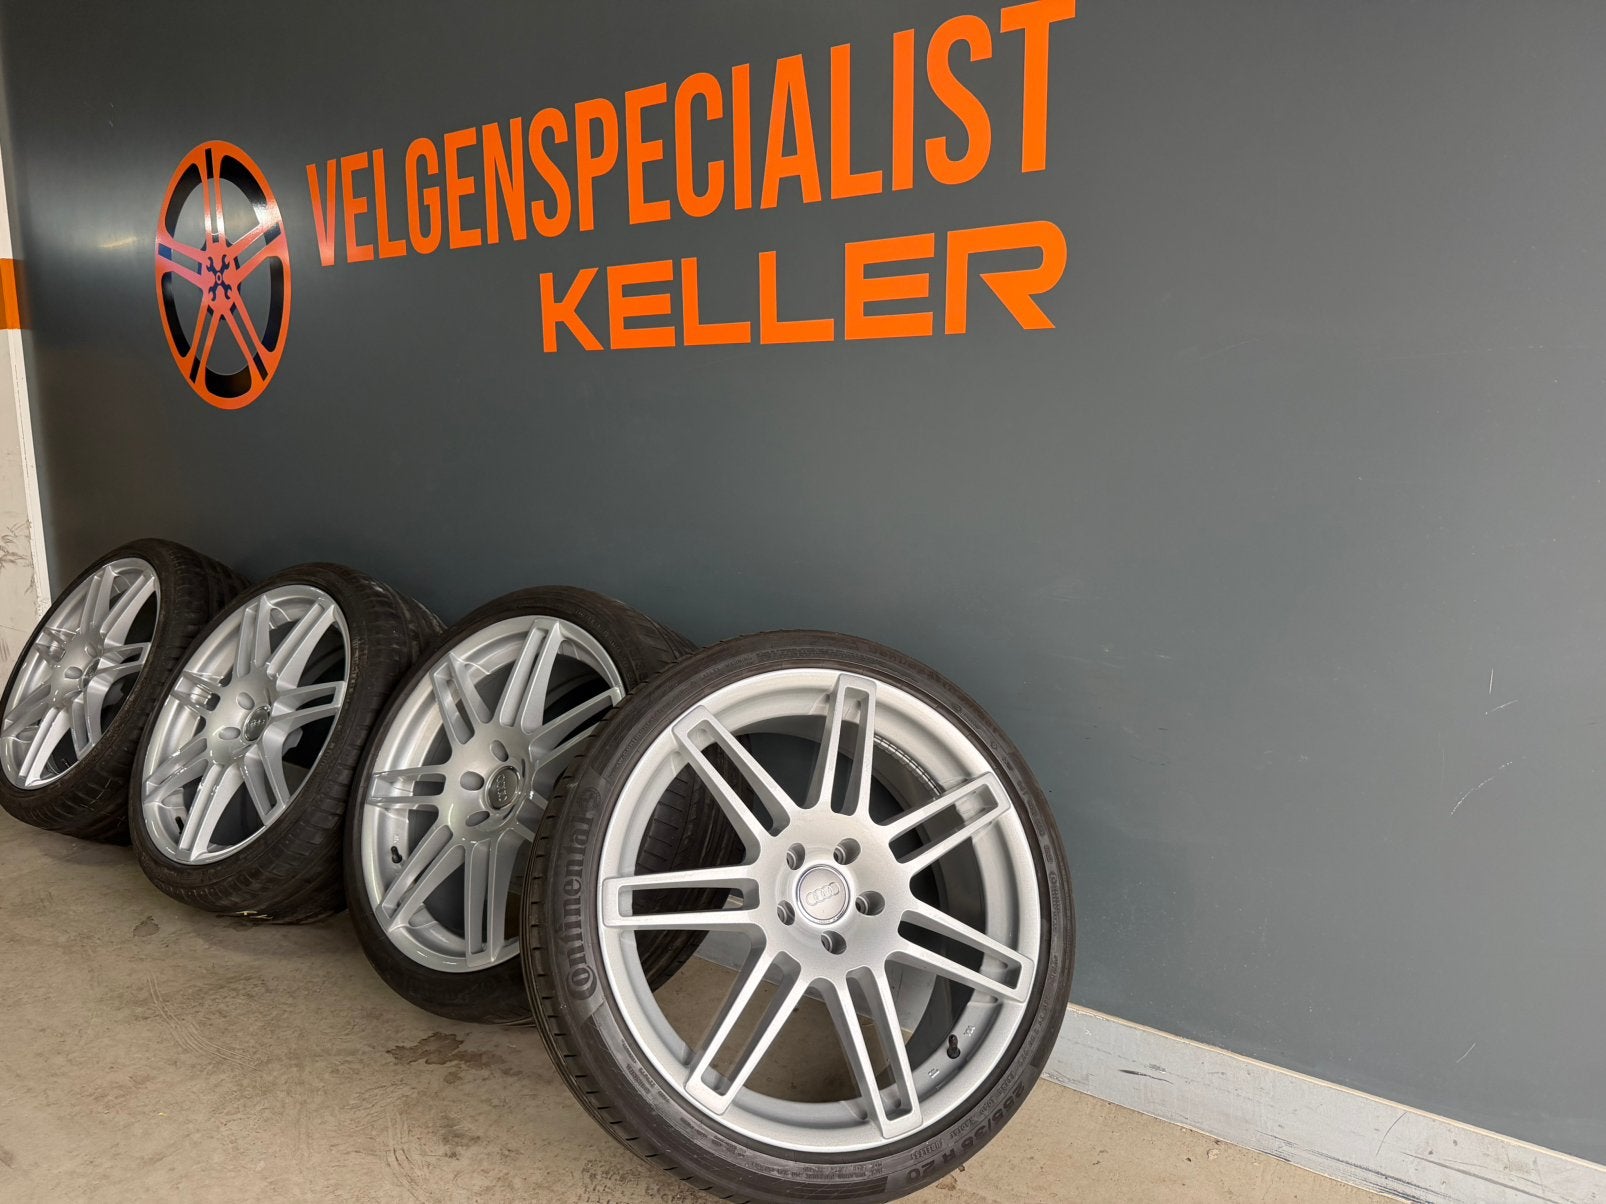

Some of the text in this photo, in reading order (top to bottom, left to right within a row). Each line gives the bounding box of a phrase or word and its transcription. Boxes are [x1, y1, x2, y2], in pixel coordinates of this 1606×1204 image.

[306, 0, 1076, 267] VELGENSPECIALIST
[539, 220, 1068, 353] KELLER
[558, 815, 598, 1000] Continental
[906, 1159, 936, 1182] 20
